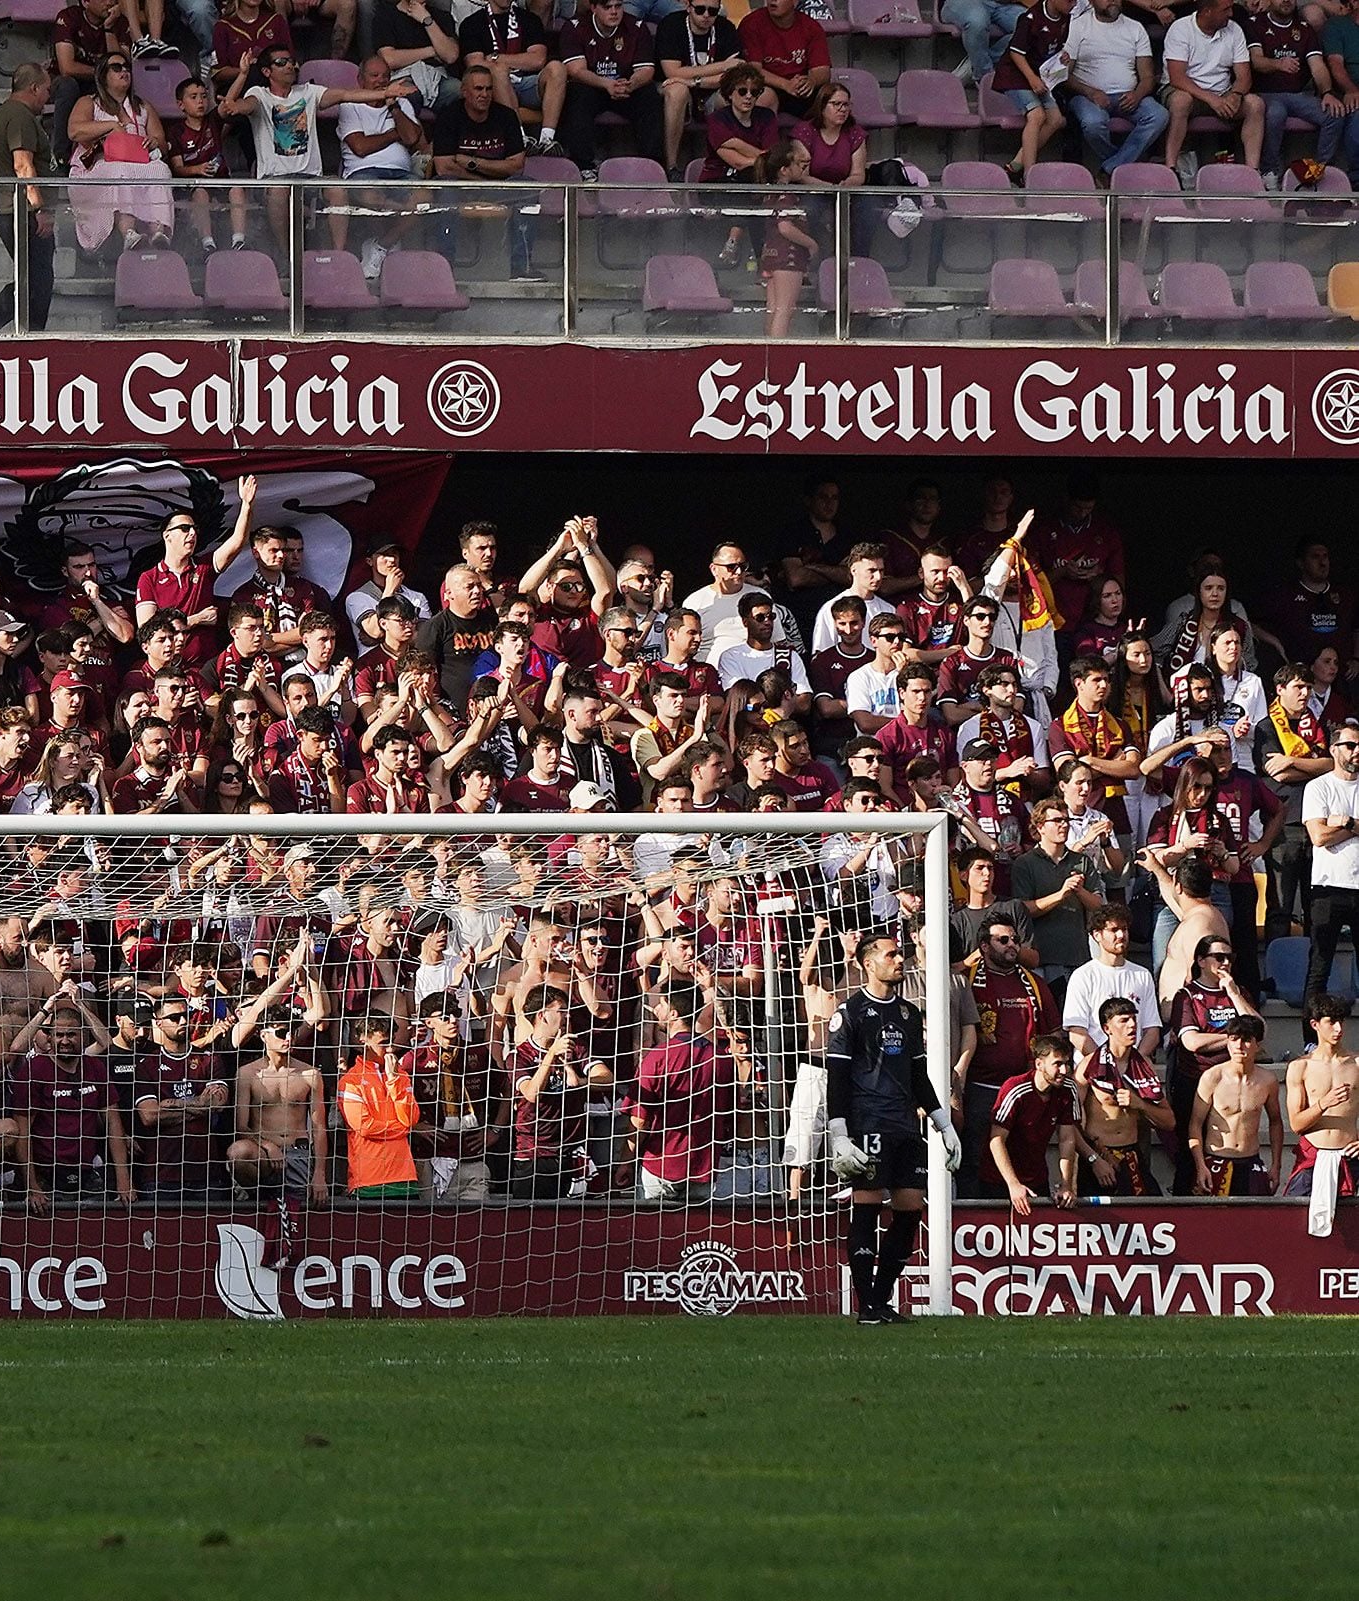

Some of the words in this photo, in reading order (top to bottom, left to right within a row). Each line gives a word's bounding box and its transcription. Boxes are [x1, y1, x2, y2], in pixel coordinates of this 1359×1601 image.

[122, 352, 405, 436] Galicia
[689, 358, 997, 442] Estrella
[1014, 360, 1292, 445] Galicia
[863, 1132, 882, 1155] 13
[679, 1238, 739, 1259] CONSERVAS
[953, 1221, 1177, 1257] CONSERVAS
[292, 1253, 469, 1310] ence
[624, 1268, 809, 1303] PESCAMAR
[841, 1263, 1275, 1317] ESCAMAR
